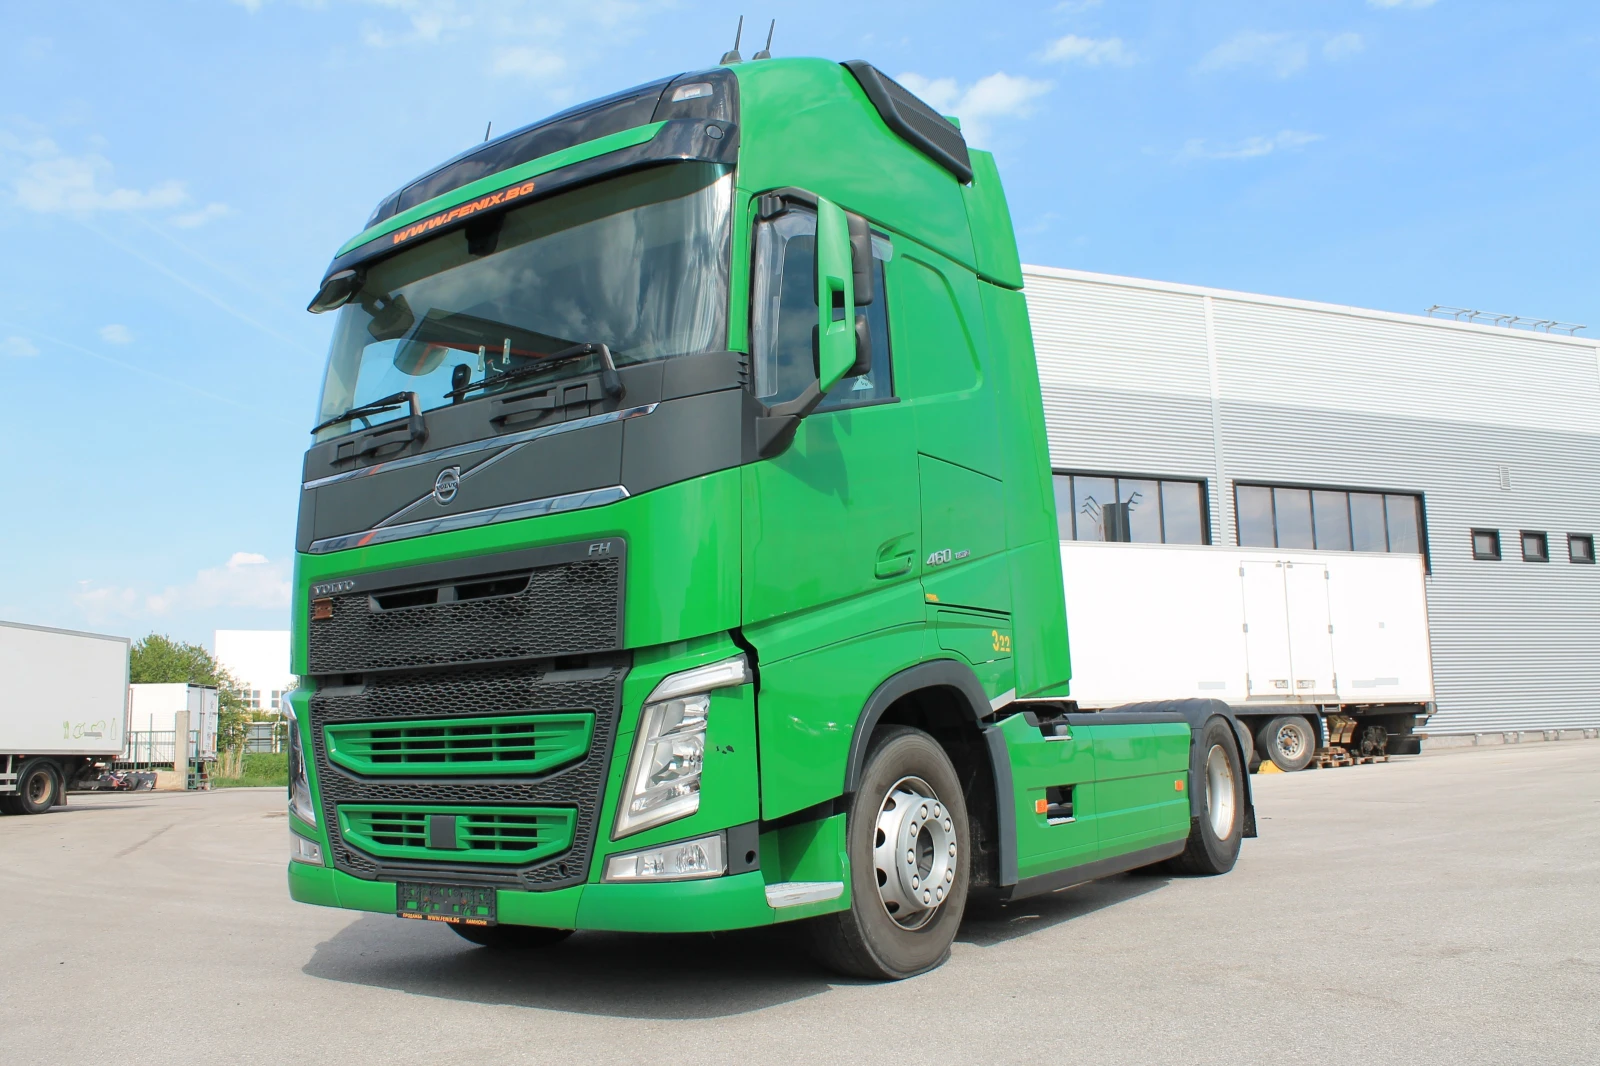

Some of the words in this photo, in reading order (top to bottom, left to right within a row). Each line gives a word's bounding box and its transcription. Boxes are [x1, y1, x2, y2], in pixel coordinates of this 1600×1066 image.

[393, 182, 535, 244] WWW.FENIX.BG
[588, 541, 612, 556] FH
[926, 548, 952, 567] 460
[313, 580, 355, 595] VOLVO
